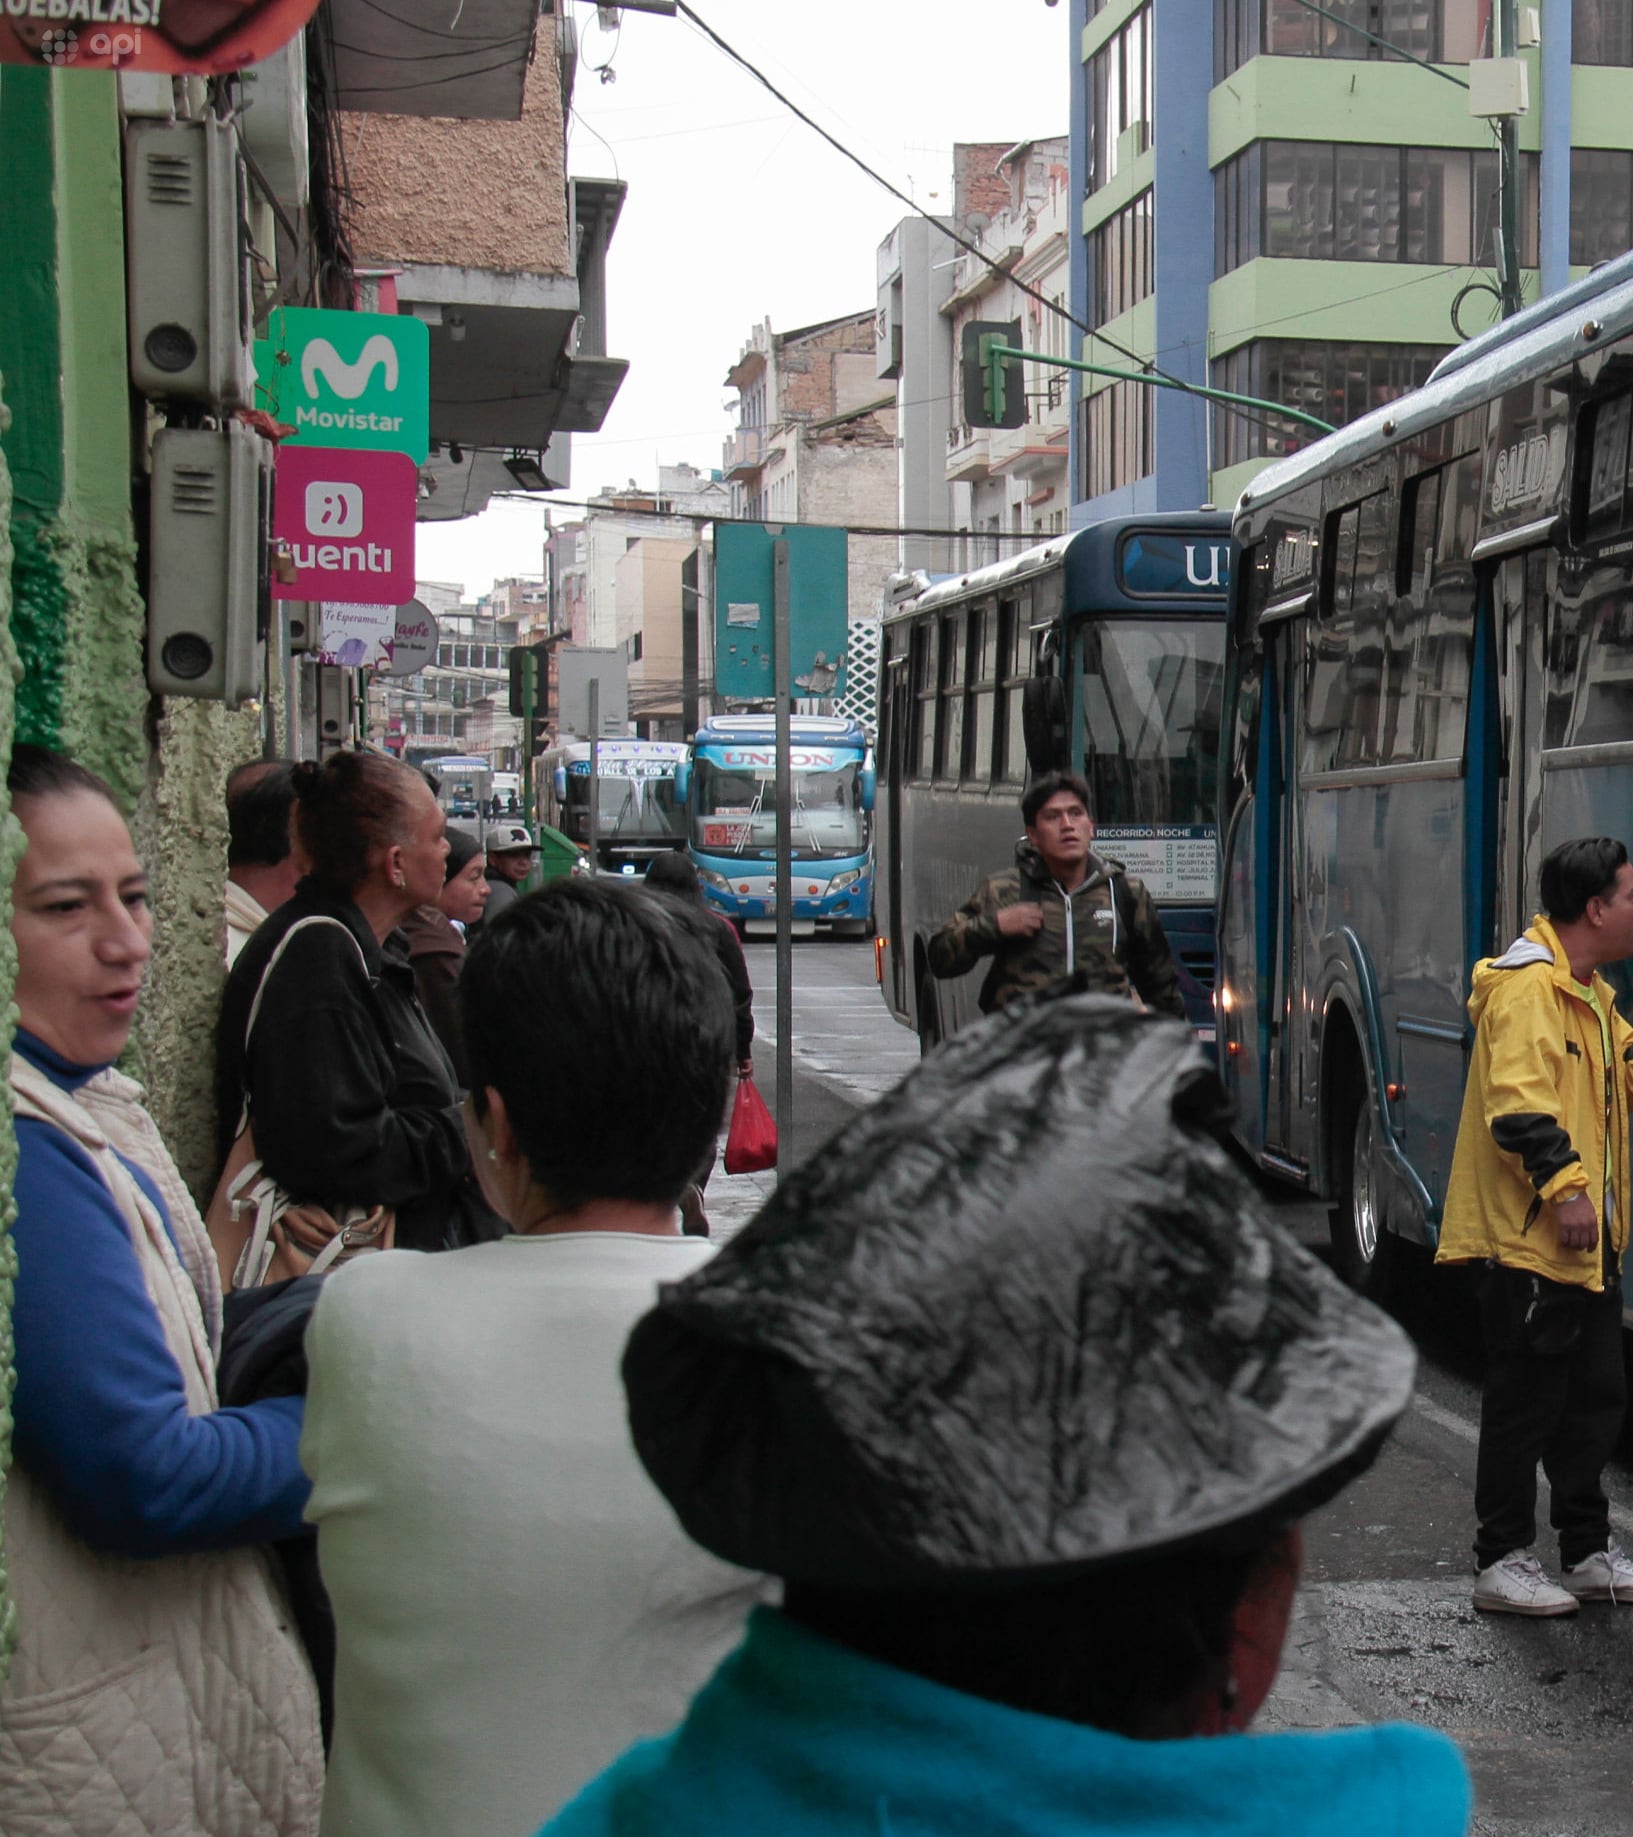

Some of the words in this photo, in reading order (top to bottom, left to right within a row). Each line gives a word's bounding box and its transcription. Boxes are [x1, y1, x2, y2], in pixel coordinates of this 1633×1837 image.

[0, 0, 161, 26] UEBALAS!
[296, 406, 403, 431] Movistar
[1273, 526, 1316, 589] SALIDA
[1156, 828, 1191, 838] NOCHE
